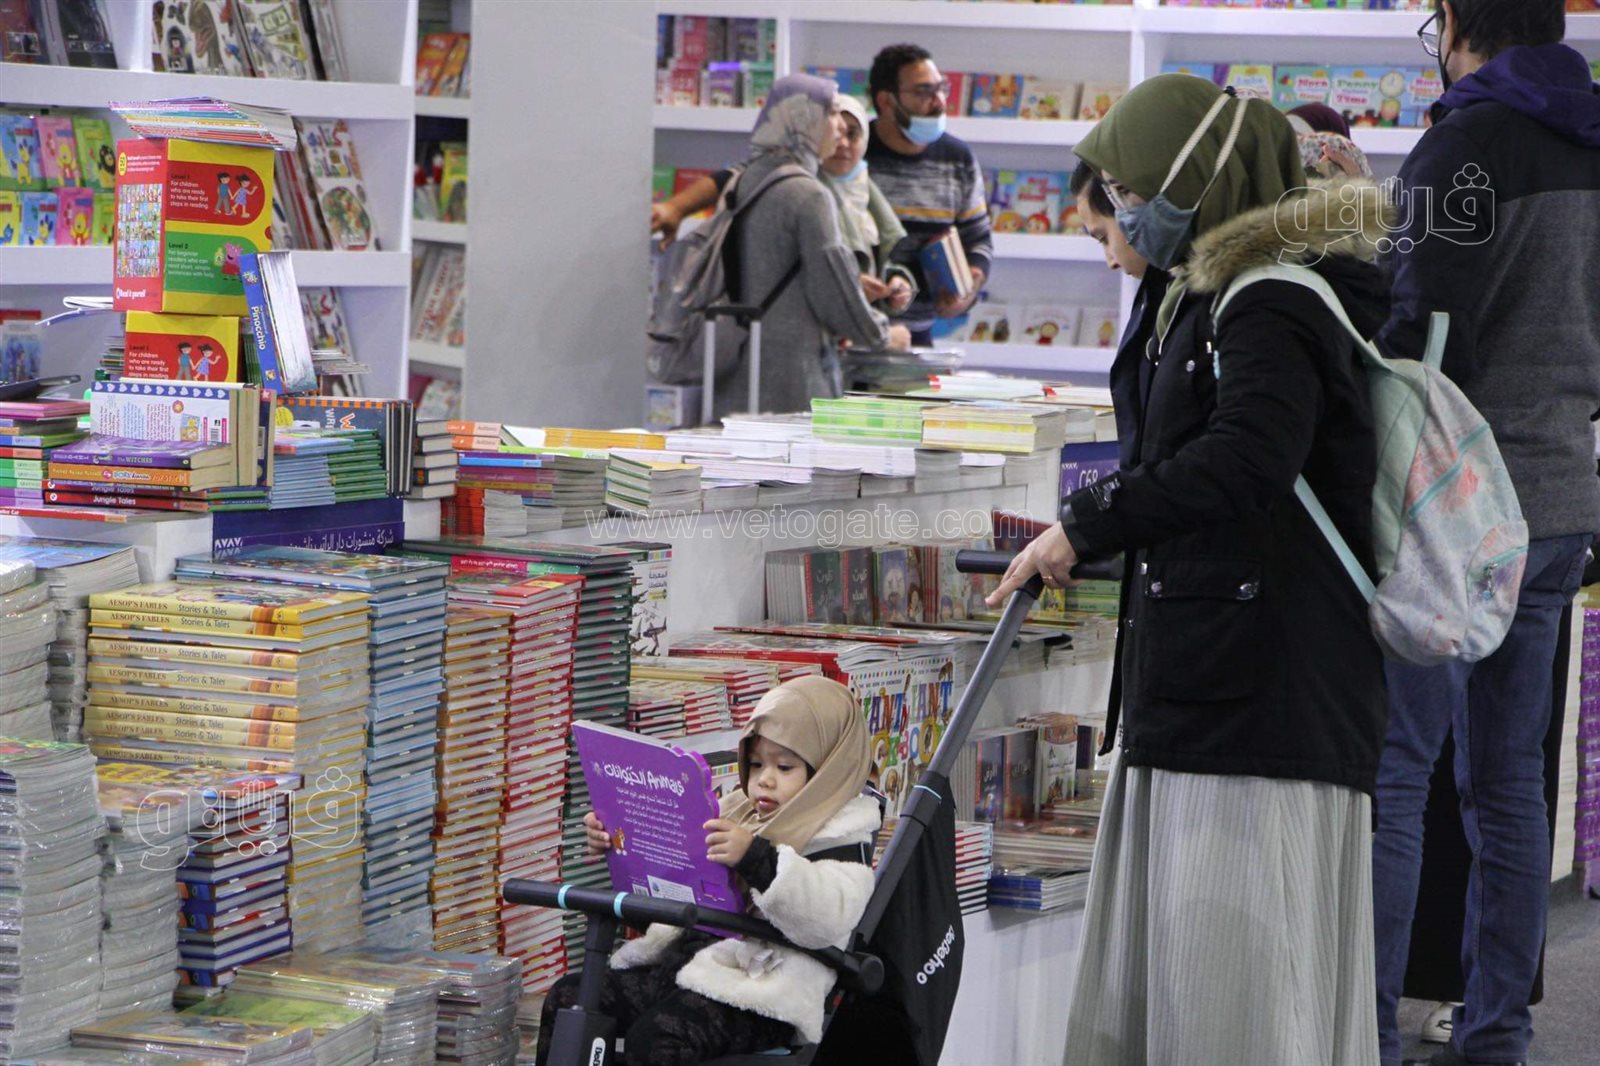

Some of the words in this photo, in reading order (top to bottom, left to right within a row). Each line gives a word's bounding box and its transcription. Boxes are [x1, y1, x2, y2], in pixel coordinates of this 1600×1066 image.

[251, 306, 266, 350] Pinocchio
[93, 494, 116, 504] Jungle
[118, 496, 136, 505] Tales
[347, 532, 376, 551] منشورات
[377, 529, 394, 547] شركة
[108, 600, 139, 608] AESOP'S
[141, 602, 168, 610] FABLES
[178, 604, 201, 614] Stories
[211, 607, 227, 616] Tales
[110, 613, 140, 621] AESOP'S
[141, 615, 170, 623] FABLES
[180, 617, 204, 626] Stories
[206, 619, 212, 628] &
[214, 620, 230, 628] Tales
[109, 644, 138, 652] AESOP'S
[140, 646, 168, 654] FABLES
[178, 648, 201, 658] Stories
[203, 650, 209, 658] &
[210, 651, 227, 660] Tales
[108, 670, 138, 678] AESOP'S
[140, 672, 167, 680] FABLES
[177, 674, 200, 684] Stories
[202, 676, 208, 684] &
[210, 677, 226, 686] Tales
[110, 697, 140, 705] AESOP'S
[140, 699, 169, 708] FABLES
[180, 702, 202, 711] Stories
[204, 704, 210, 712] &
[212, 705, 228, 714] Tales
[138, 714, 165, 723] FABLES
[176, 717, 199, 726] Stories
[200, 719, 206, 727] &
[208, 720, 224, 728] Tales
[174, 729, 198, 738] Stories
[199, 731, 205, 739] &
[207, 732, 223, 740] Tales
[647, 770, 685, 796] Animals
